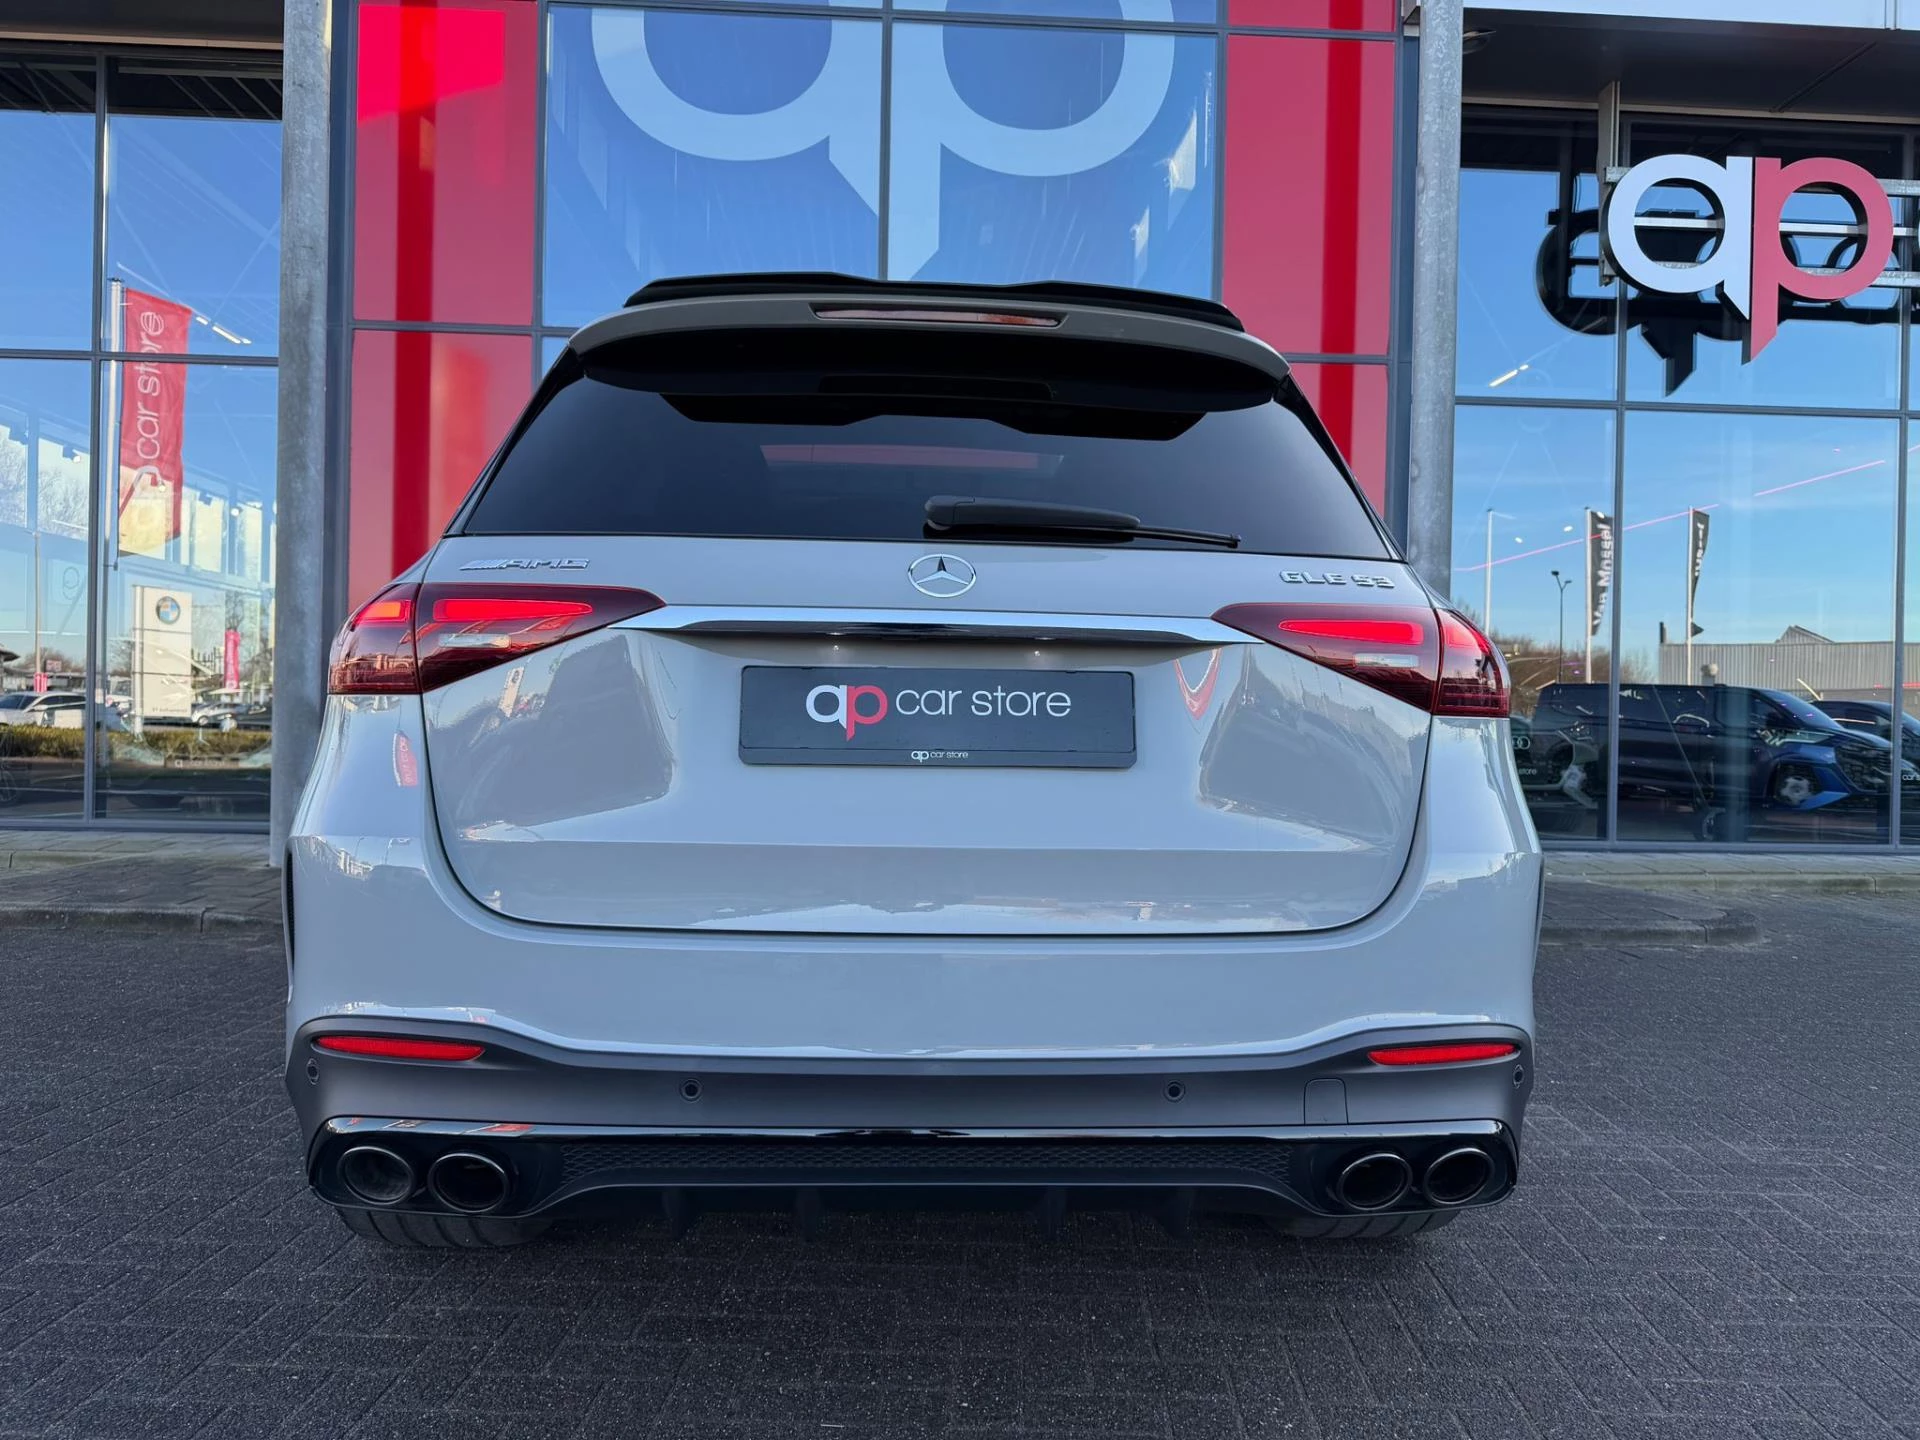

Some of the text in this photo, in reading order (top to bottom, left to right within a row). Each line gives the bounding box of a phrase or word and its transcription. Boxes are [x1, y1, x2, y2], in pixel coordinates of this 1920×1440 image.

[1607, 154, 1894, 361] ap
[136, 402, 161, 460] car
[1280, 571, 1395, 589] GLE 53
[1597, 523, 1613, 587] Mossel
[805, 684, 1072, 742] ap car store
[911, 750, 930, 763] ap
[946, 751, 969, 759] store
